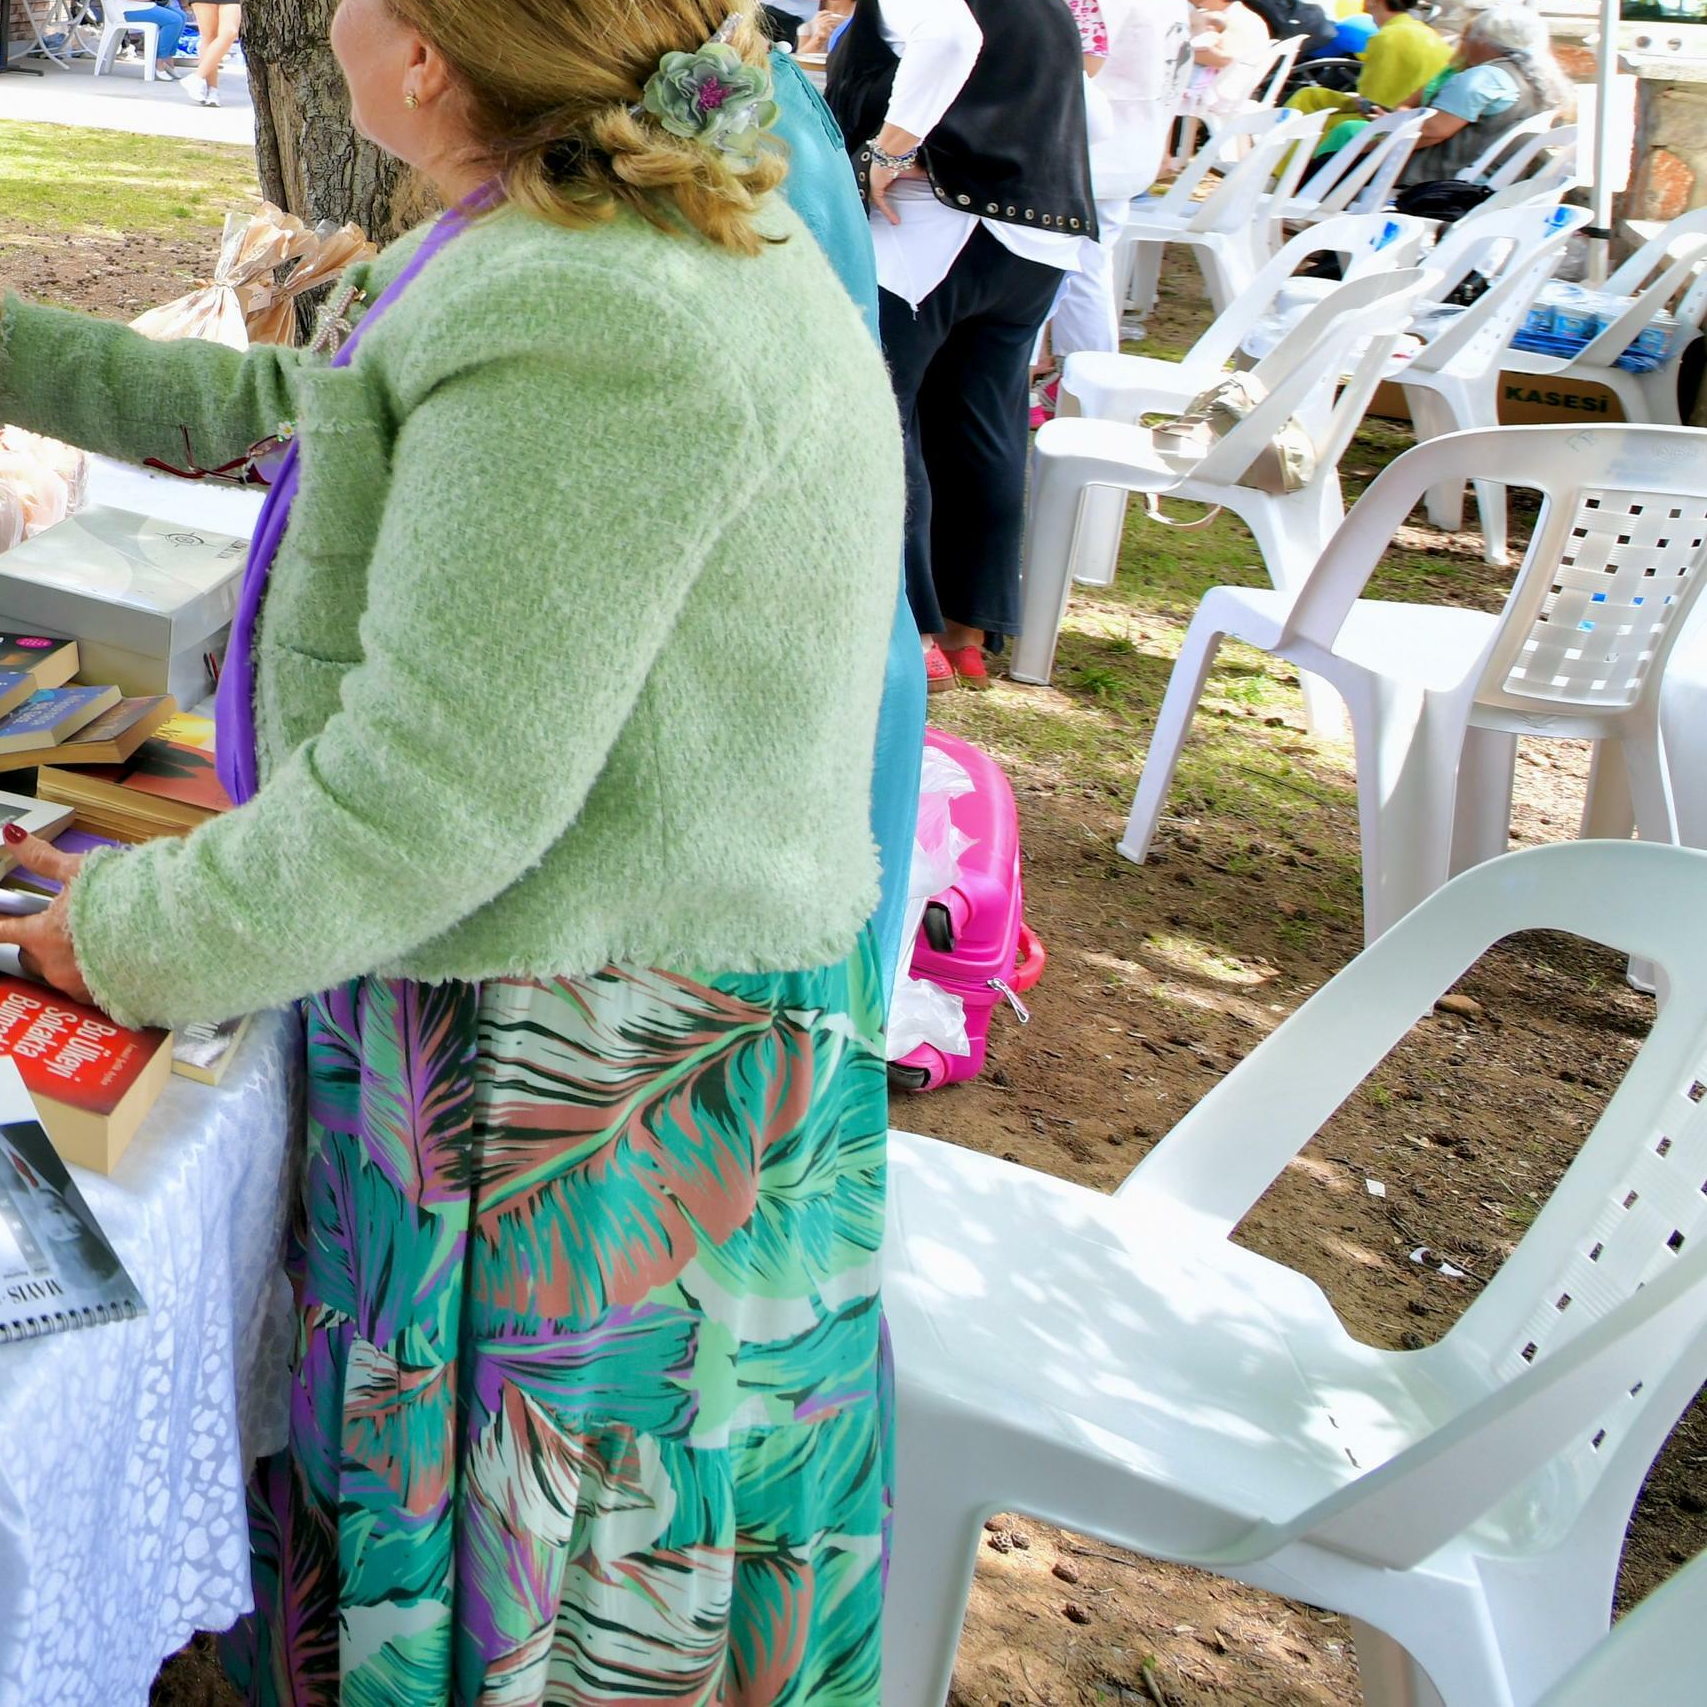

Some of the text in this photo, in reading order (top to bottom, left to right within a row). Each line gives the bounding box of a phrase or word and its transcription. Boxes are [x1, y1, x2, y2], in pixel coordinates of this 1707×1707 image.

[12, 1006, 78, 1058] Sokakta
[43, 1019, 117, 1082] Bu Ülkeyi
[8, 1276, 64, 1305] MAYIS
